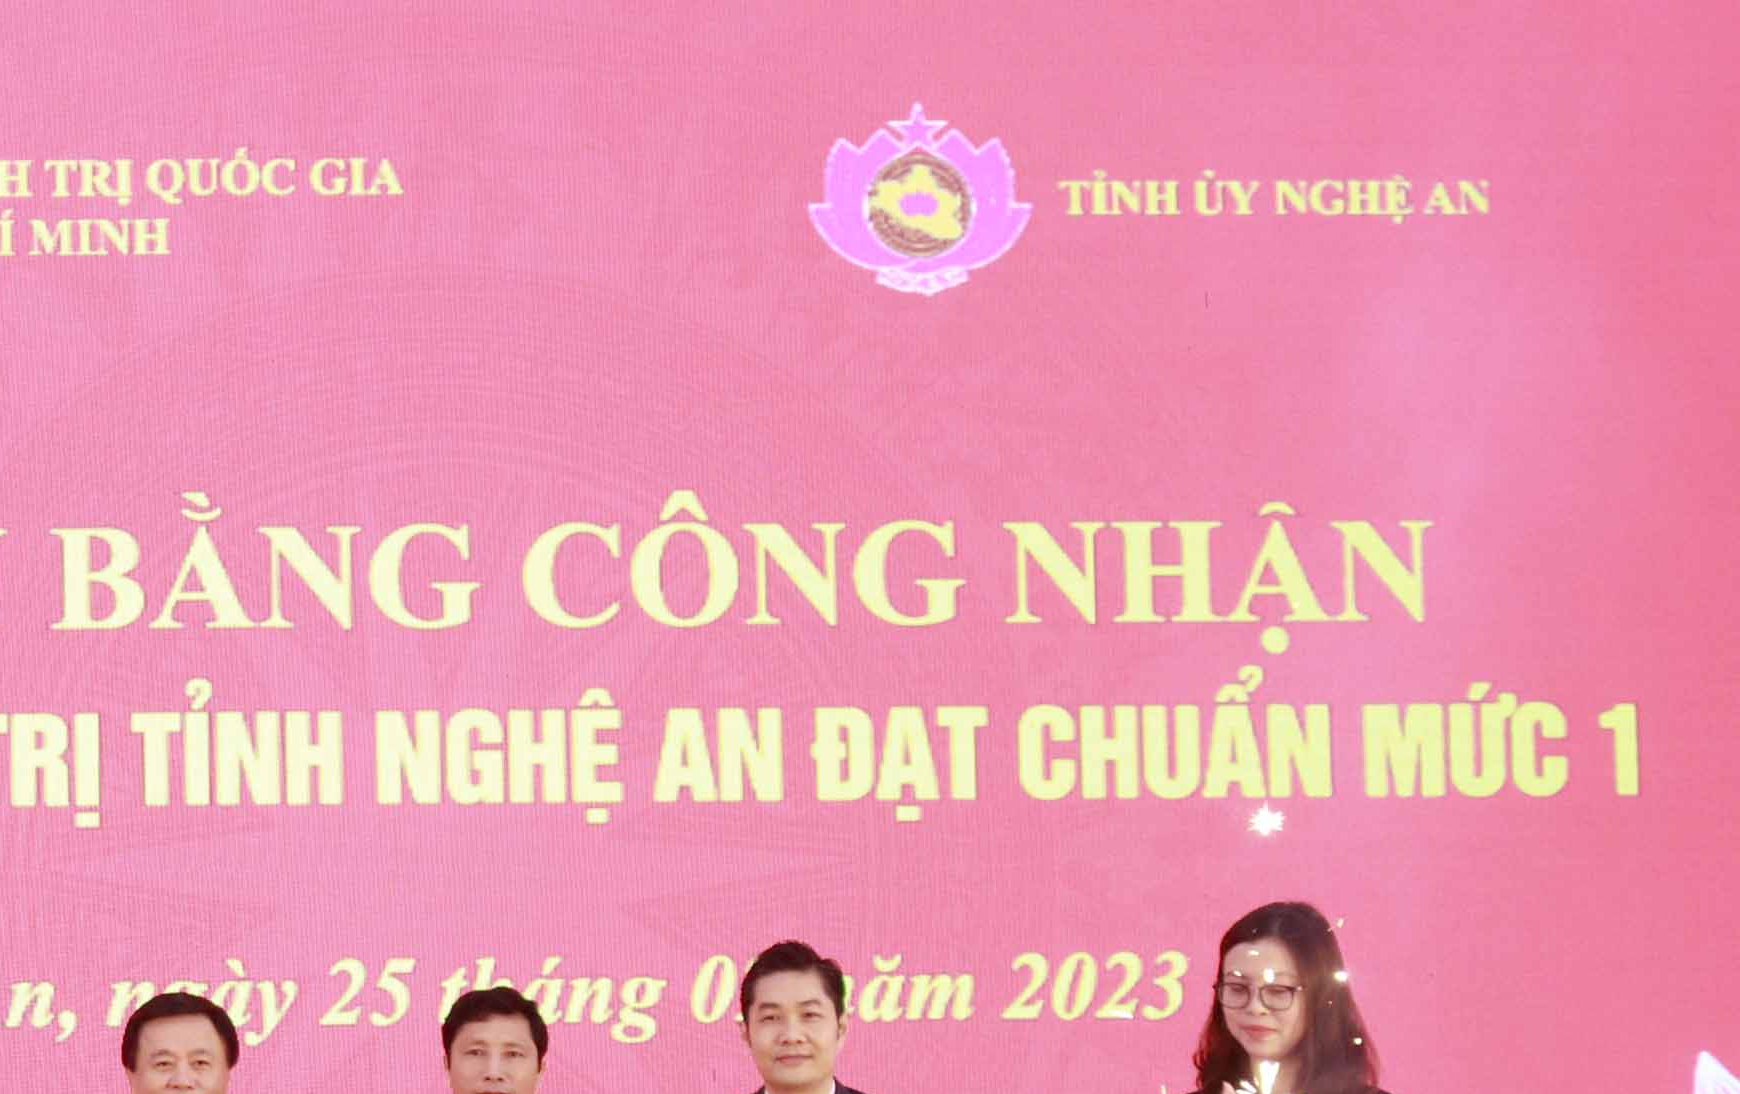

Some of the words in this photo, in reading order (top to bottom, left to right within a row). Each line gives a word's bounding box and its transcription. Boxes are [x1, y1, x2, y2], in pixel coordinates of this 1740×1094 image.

[45, 158, 134, 207] TRỊ
[146, 146, 297, 206] QUỐC
[308, 156, 404, 197] GIA
[1058, 168, 1180, 217] TỈNH
[1194, 168, 1260, 216] ỦY
[1274, 174, 1414, 224] NGHỆ
[1424, 179, 1490, 215] AN
[30, 217, 170, 258] MINH
[50, 490, 482, 632] BẰNG
[520, 489, 967, 630] CÔNG
[1001, 500, 1432, 655] NHẬN
[130, 677, 345, 808] TỈNH
[374, 686, 625, 826] NGHỆ
[652, 705, 785, 804] AN
[808, 704, 990, 823] ĐẠT
[1016, 663, 1335, 802] CHUẨN
[1362, 680, 1569, 799] MỨC
[1597, 702, 1640, 797] 1
[105, 957, 299, 1046] này
[318, 956, 417, 1027] 25
[690, 953, 757, 1024] 0
[1000, 949, 1190, 1022] 2023
